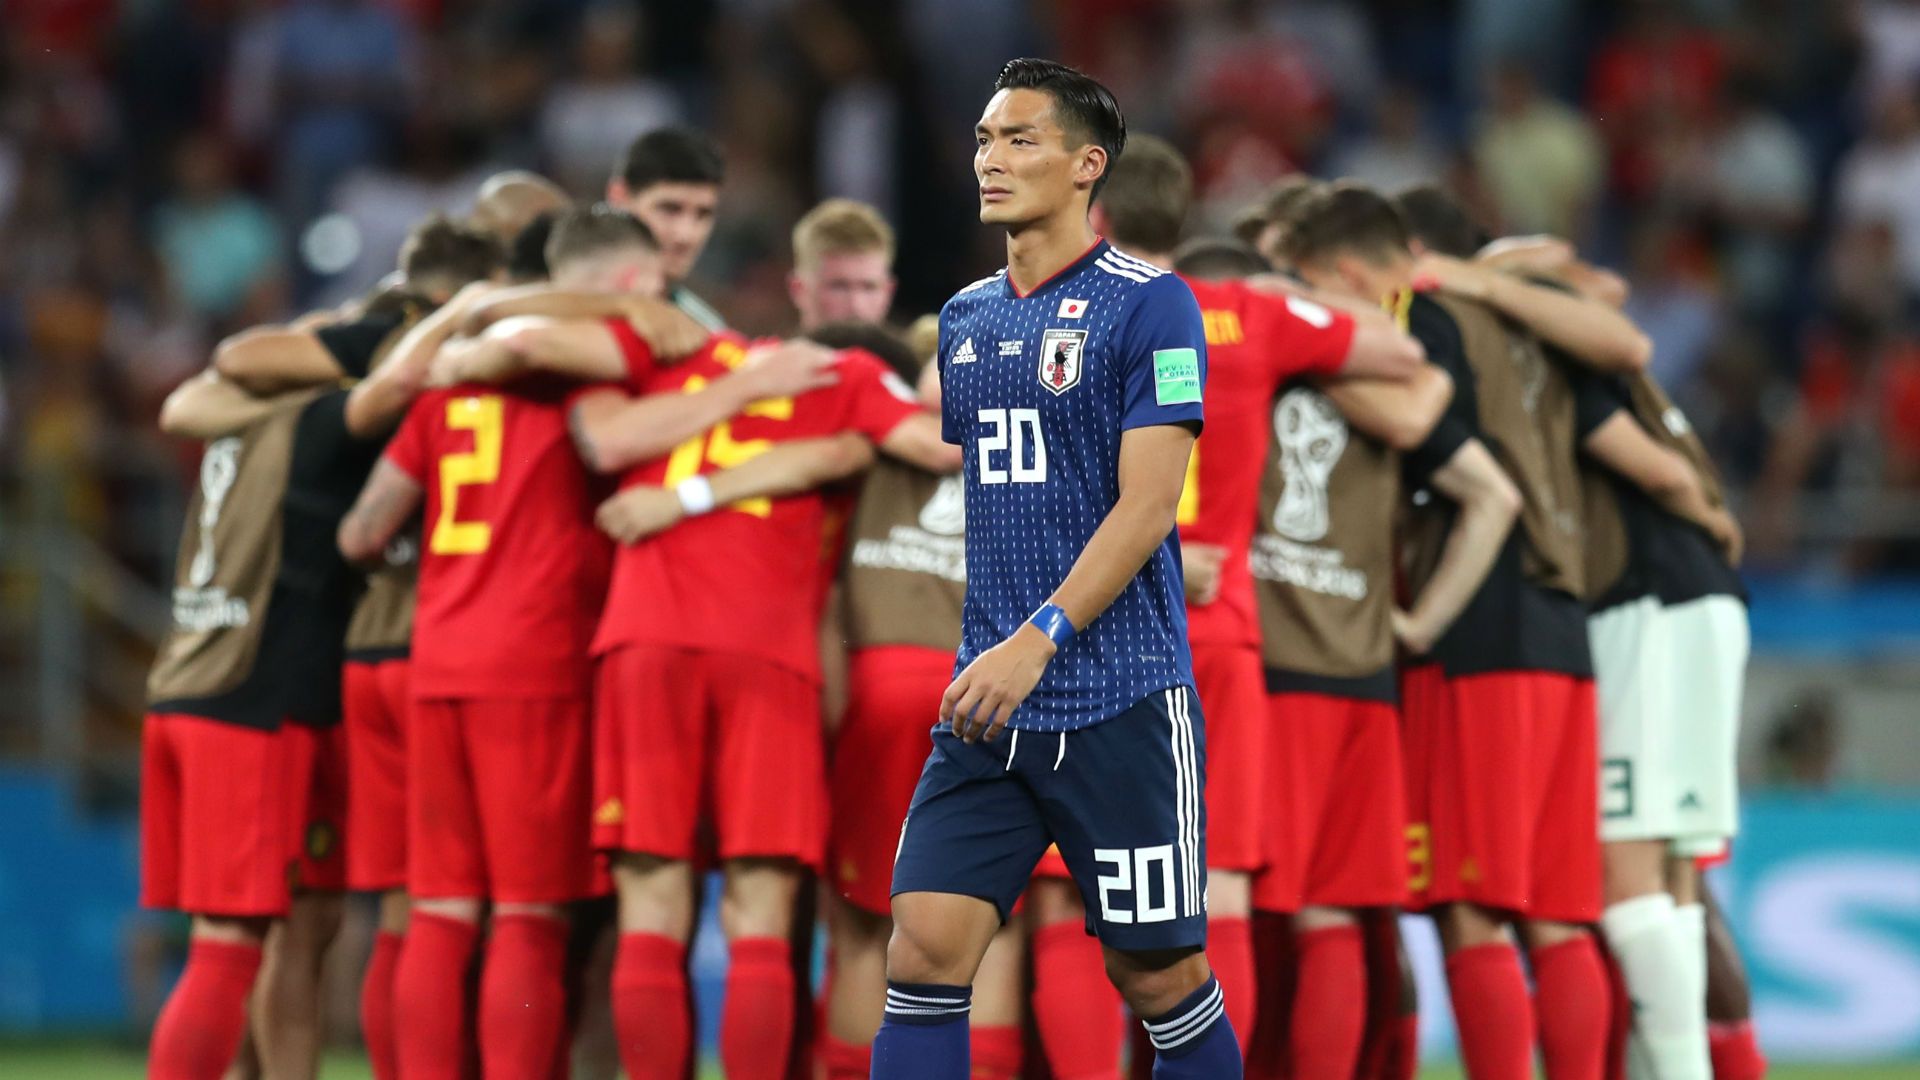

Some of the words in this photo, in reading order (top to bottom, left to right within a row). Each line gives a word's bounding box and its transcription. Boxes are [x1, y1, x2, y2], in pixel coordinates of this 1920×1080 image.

[430, 395, 504, 555] 2
[978, 408, 1047, 484] 20
[1601, 757, 1633, 818] 3
[1094, 844, 1176, 923] 20
[1405, 822, 1432, 891] 3
